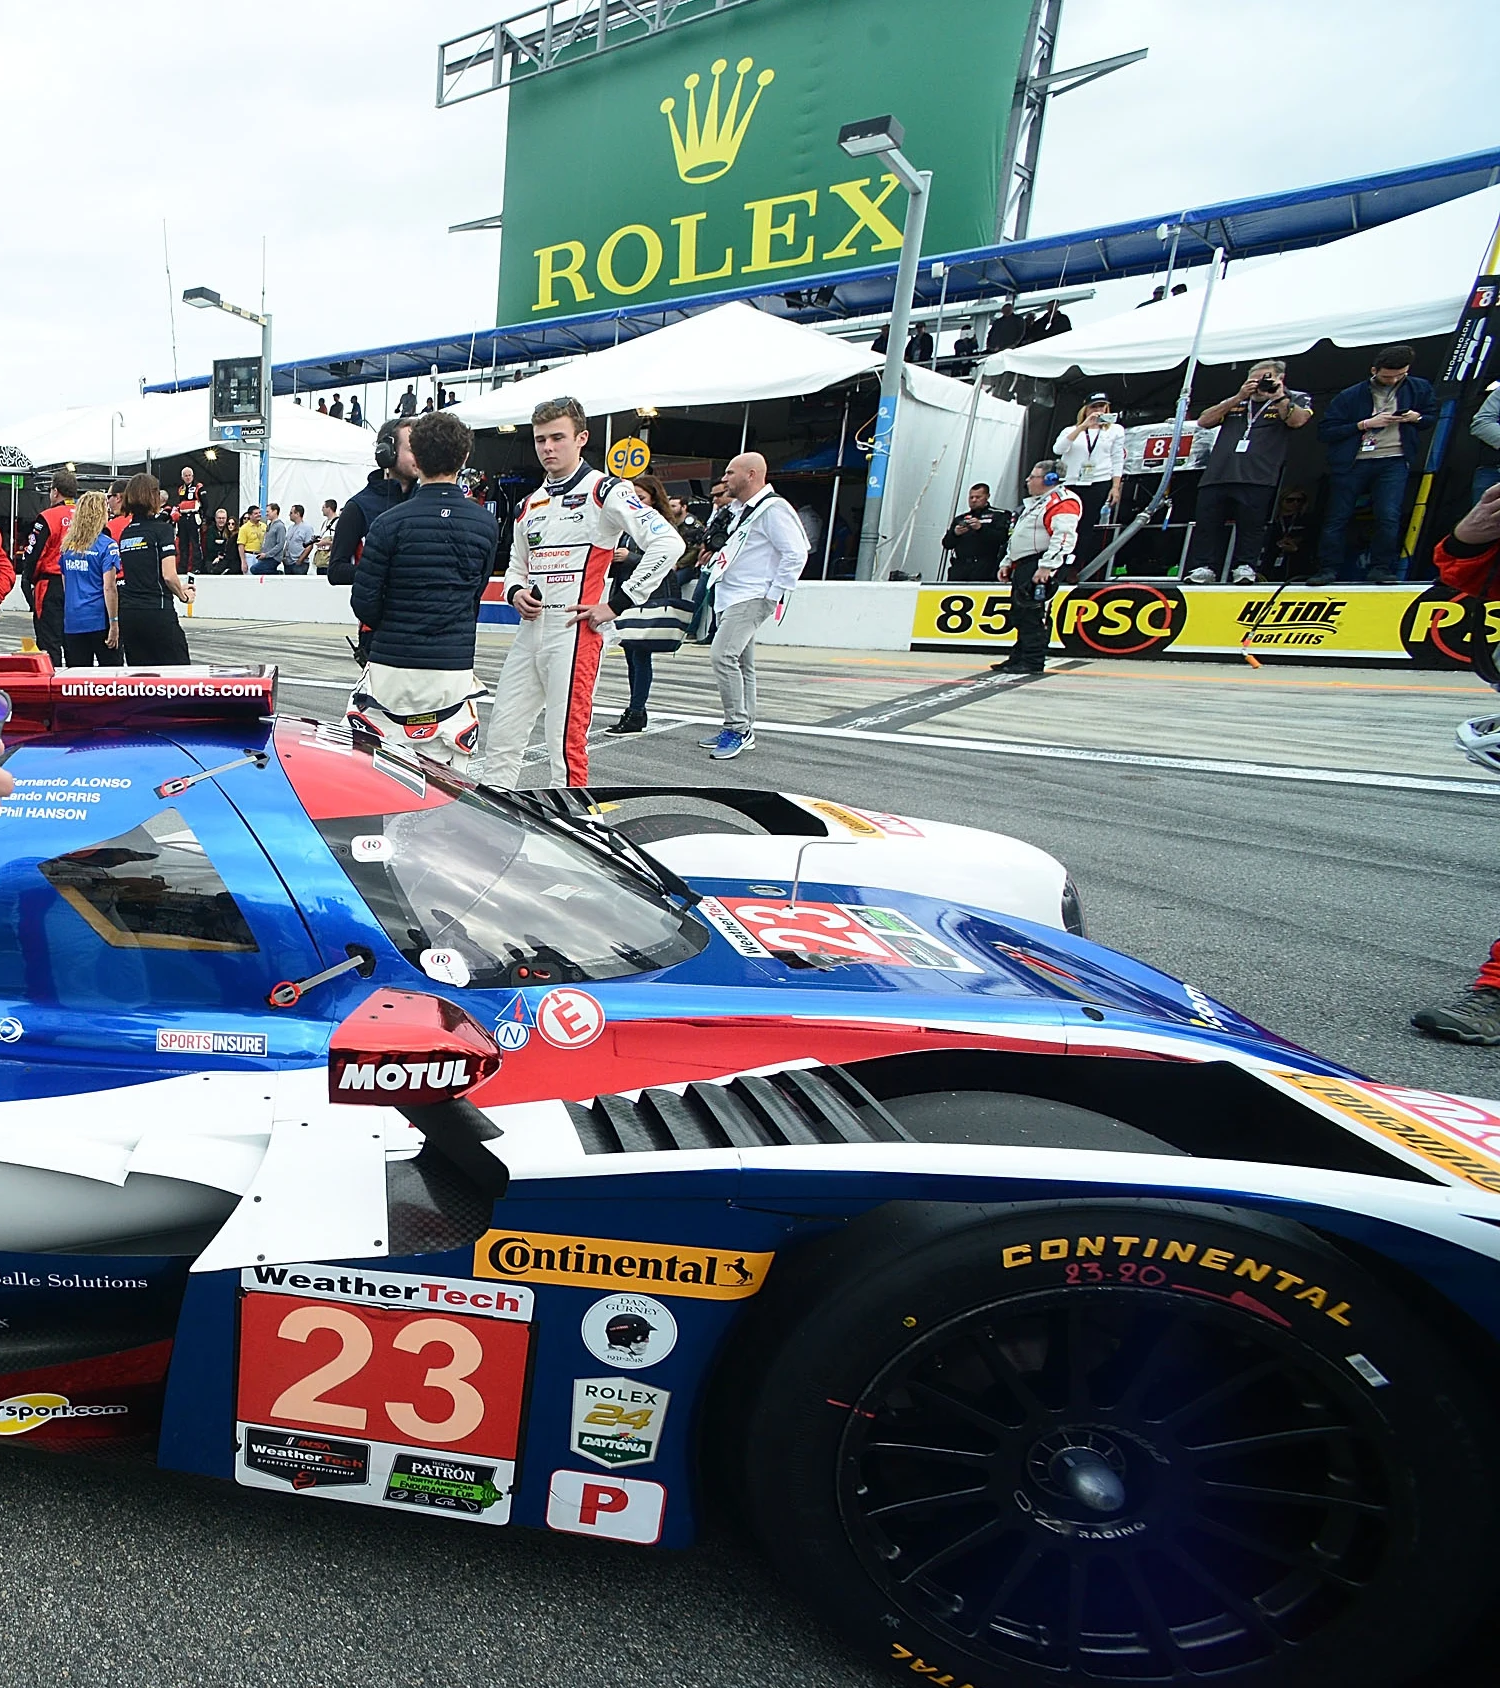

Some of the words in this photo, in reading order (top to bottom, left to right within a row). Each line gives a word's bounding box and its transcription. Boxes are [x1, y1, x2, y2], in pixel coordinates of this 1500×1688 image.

[532, 173, 904, 312] ROLEX
[613, 448, 645, 469] 96
[548, 575, 574, 583] MOTUL
[1062, 599, 1179, 637] PSC
[1283, 631, 1324, 645] Lifts
[61, 681, 263, 699] unitedautosports.com
[71, 778, 132, 788] ALONSO
[45, 792, 101, 803] NORRIS
[25, 807, 87, 820] HANSON
[338, 1059, 471, 1090] MOTUL
[488, 1236, 718, 1286] Continental
[48, 1274, 148, 1289] Solutions
[253, 1266, 520, 1313] WeatherTech
[1002, 1235, 1354, 1327] CONTINENTAL
[605, 1303, 659, 1315] GURNEY
[620, 1298, 647, 1307] DAN
[606, 1354, 644, 1363] 1931-2018
[270, 1305, 485, 1443] 23
[585, 1384, 658, 1405] ROLEX
[583, 1403, 654, 1430] 24
[297, 1439, 331, 1451] IMSA
[582, 1435, 647, 1454] DAYTONA
[251, 1443, 363, 1468] WeatherTech
[257, 1458, 298, 1468] SPORTSCAR
[301, 1464, 355, 1476] CHAMPIONSHIP
[411, 1462, 476, 1482] PATRÓN
[400, 1480, 453, 1495] ENDURANCE
[455, 1489, 475, 1498] CUP
[407, 1475, 435, 1486] NORTH
[435, 1479, 474, 1491] AMERICAN
[579, 1482, 629, 1525] P
[1078, 1521, 1148, 1540] RACING
